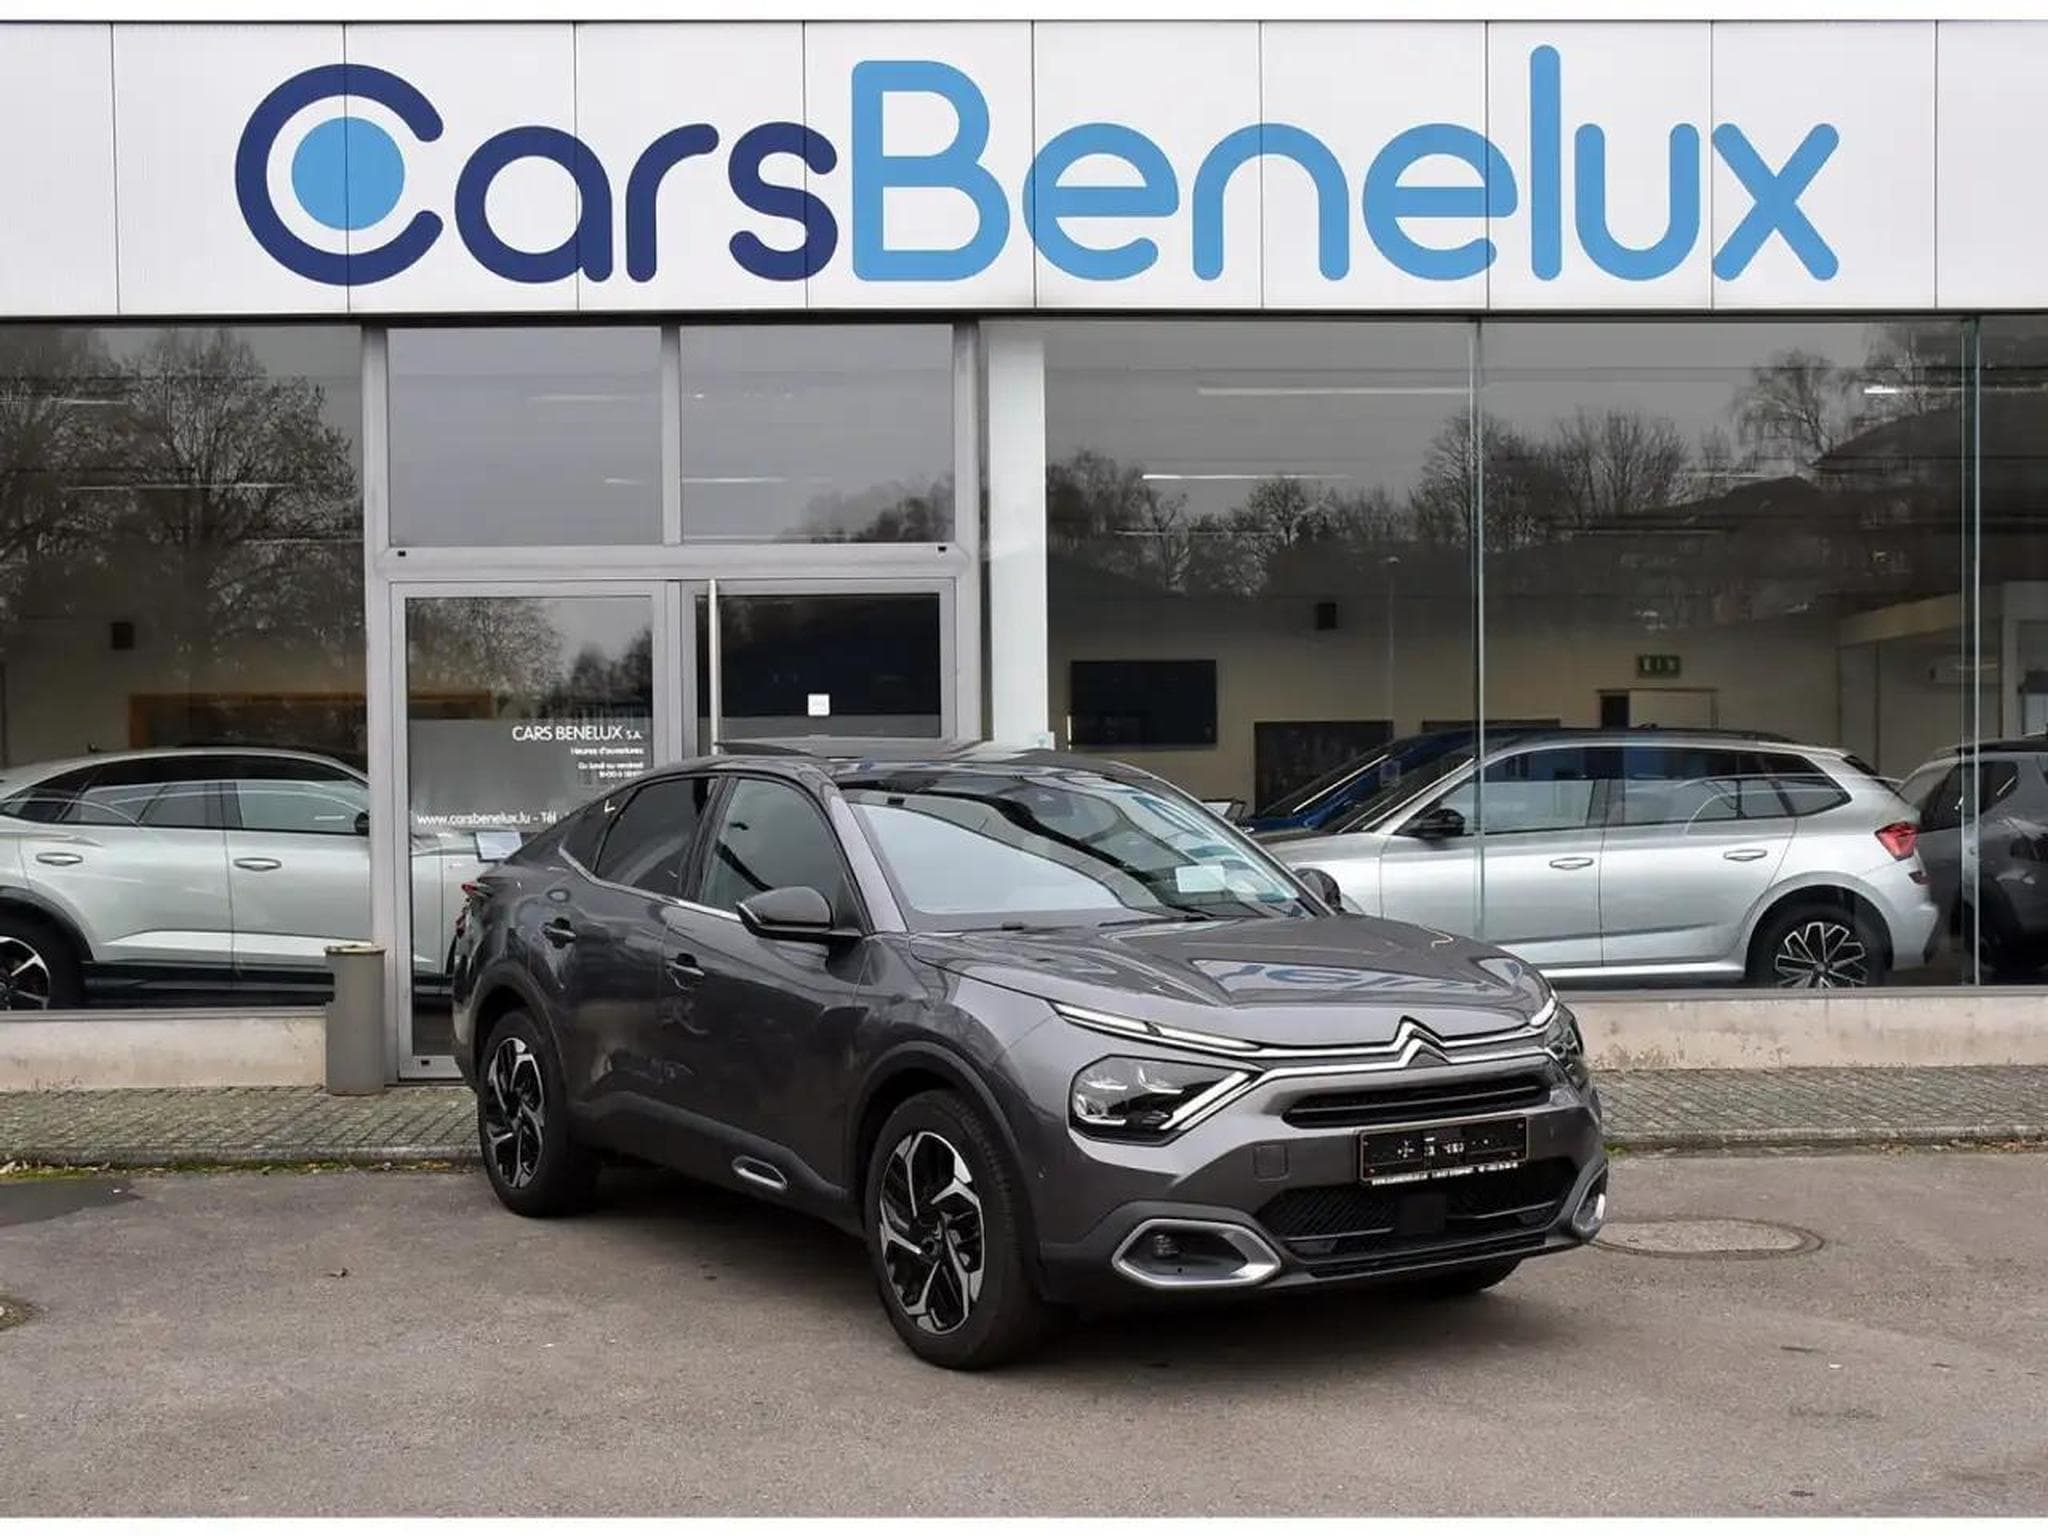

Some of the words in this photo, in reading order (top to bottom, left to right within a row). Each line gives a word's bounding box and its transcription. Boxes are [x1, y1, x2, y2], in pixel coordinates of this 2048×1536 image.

[512, 725, 553, 741] CARS
[555, 725, 622, 741] BENELUX
[416, 811, 530, 825] www.carsbenelux.lu
